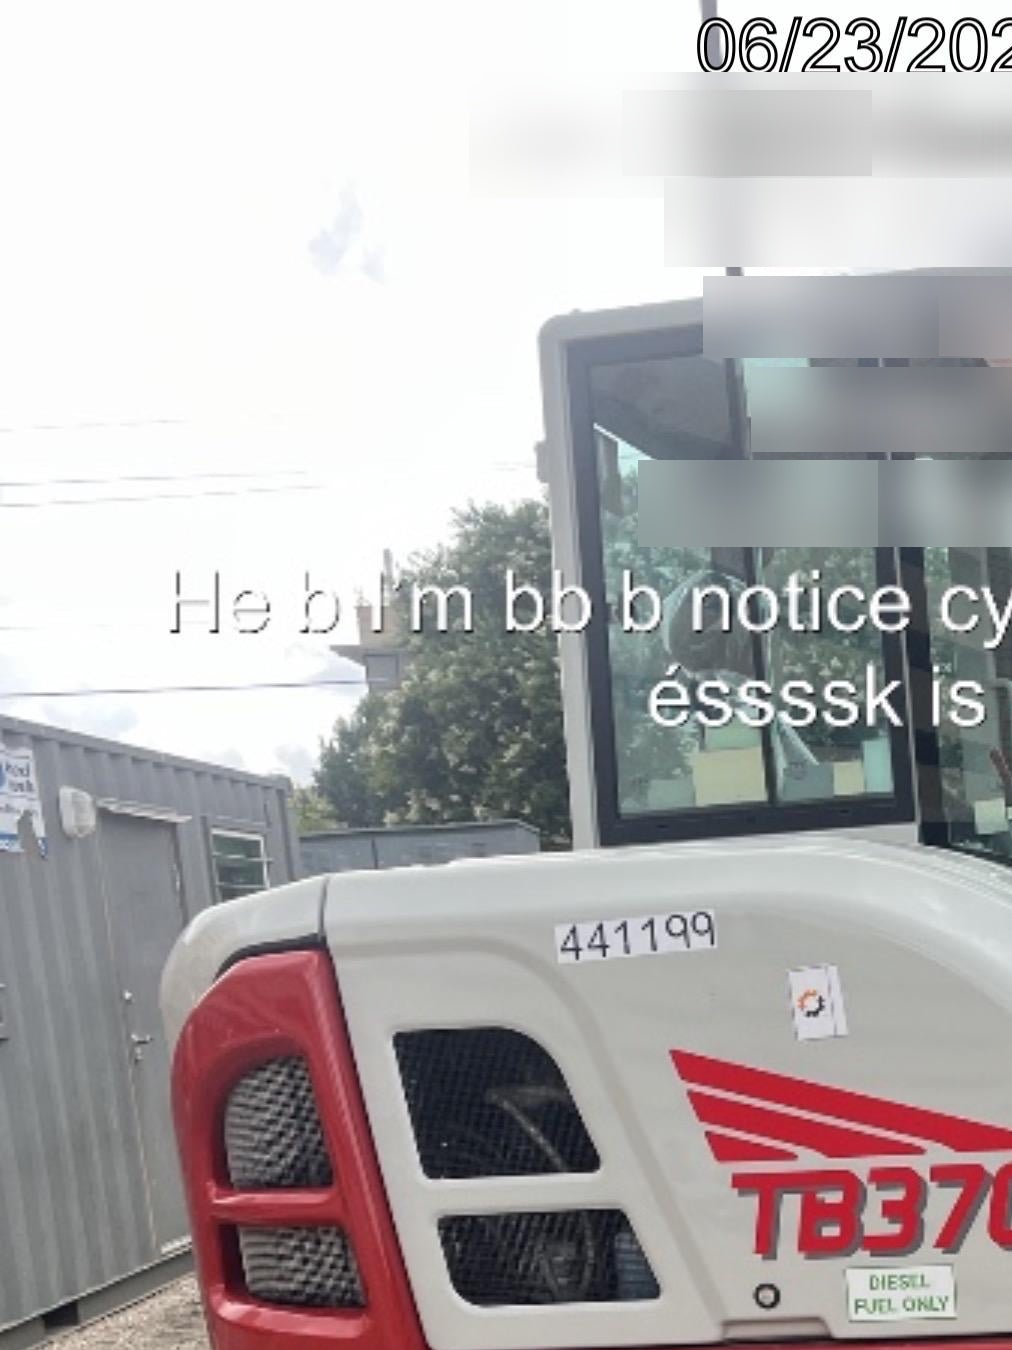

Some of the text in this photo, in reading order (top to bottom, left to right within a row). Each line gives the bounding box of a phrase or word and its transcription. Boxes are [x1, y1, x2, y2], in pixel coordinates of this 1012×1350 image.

[560, 910, 716, 961] 441199
[868, 1273, 931, 1291] DIESEL
[854, 1295, 949, 1315] FUEL ONLY
